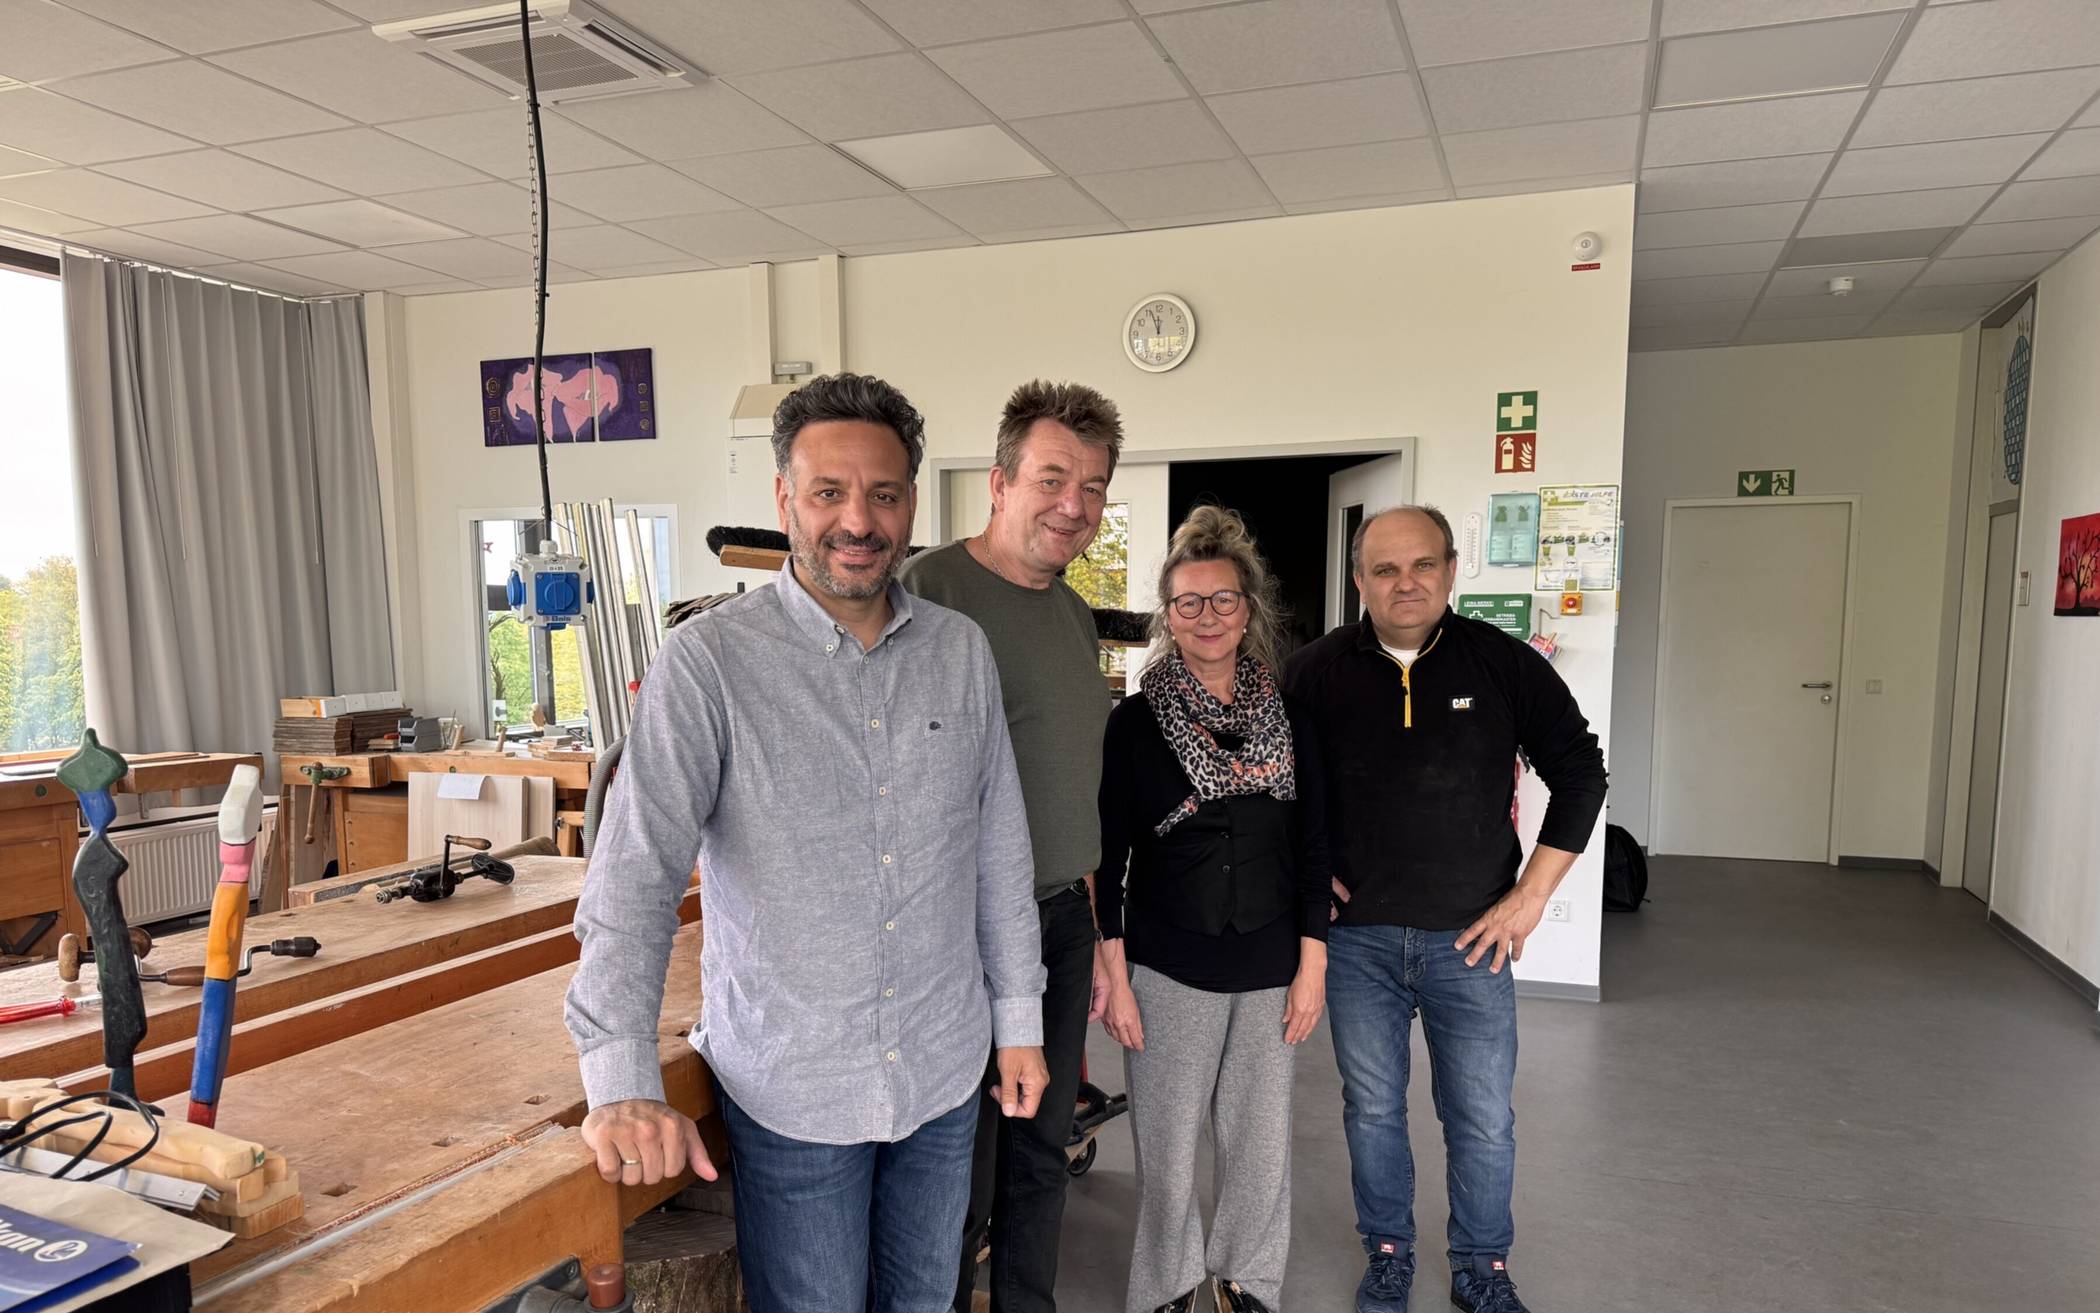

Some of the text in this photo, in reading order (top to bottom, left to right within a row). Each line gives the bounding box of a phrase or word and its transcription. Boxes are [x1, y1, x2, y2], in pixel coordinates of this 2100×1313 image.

[1156, 304, 1163, 312] 12
[1137, 319, 1145, 327] 10
[1175, 315, 1181, 323] 2
[1179, 327, 1184, 335] 3
[1452, 697, 1473, 709] CAT
